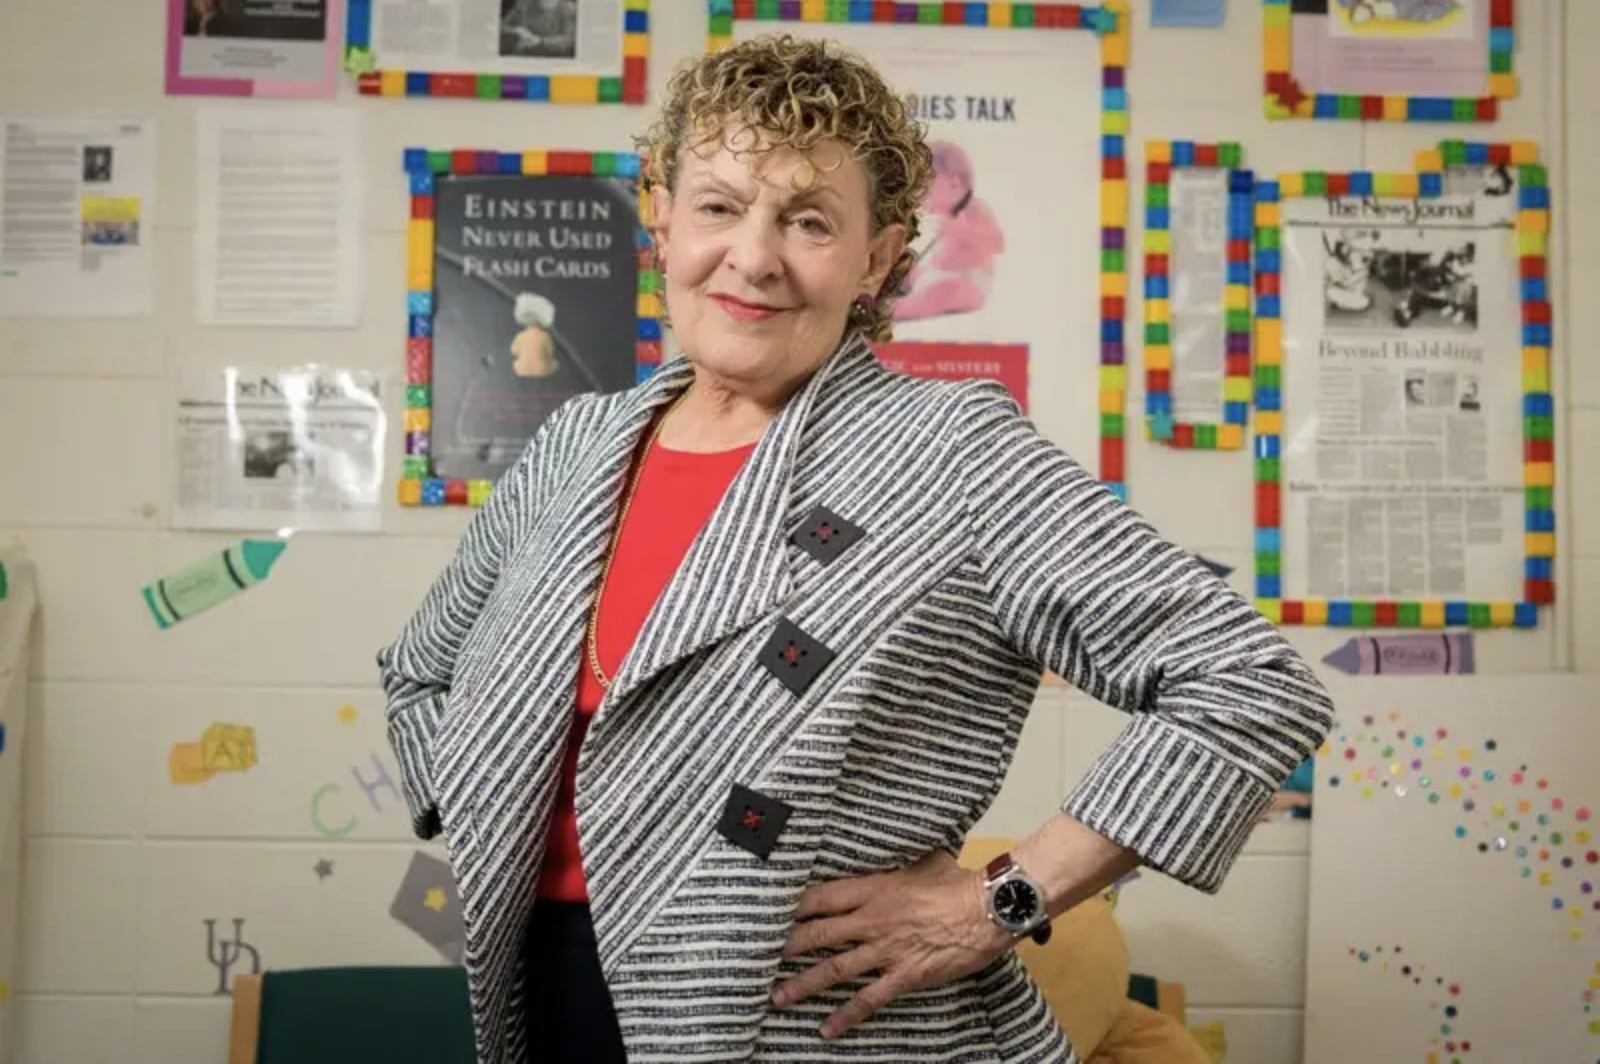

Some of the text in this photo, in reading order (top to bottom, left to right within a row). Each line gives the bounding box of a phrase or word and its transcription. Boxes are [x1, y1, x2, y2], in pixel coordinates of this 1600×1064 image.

[965, 96, 1016, 121] TALK
[464, 194, 610, 220] EINSTEIN
[1328, 198, 1357, 216] The
[1404, 198, 1474, 226] Journal
[462, 226, 612, 249] NEVER USED
[462, 255, 611, 278] FLASH CARDS
